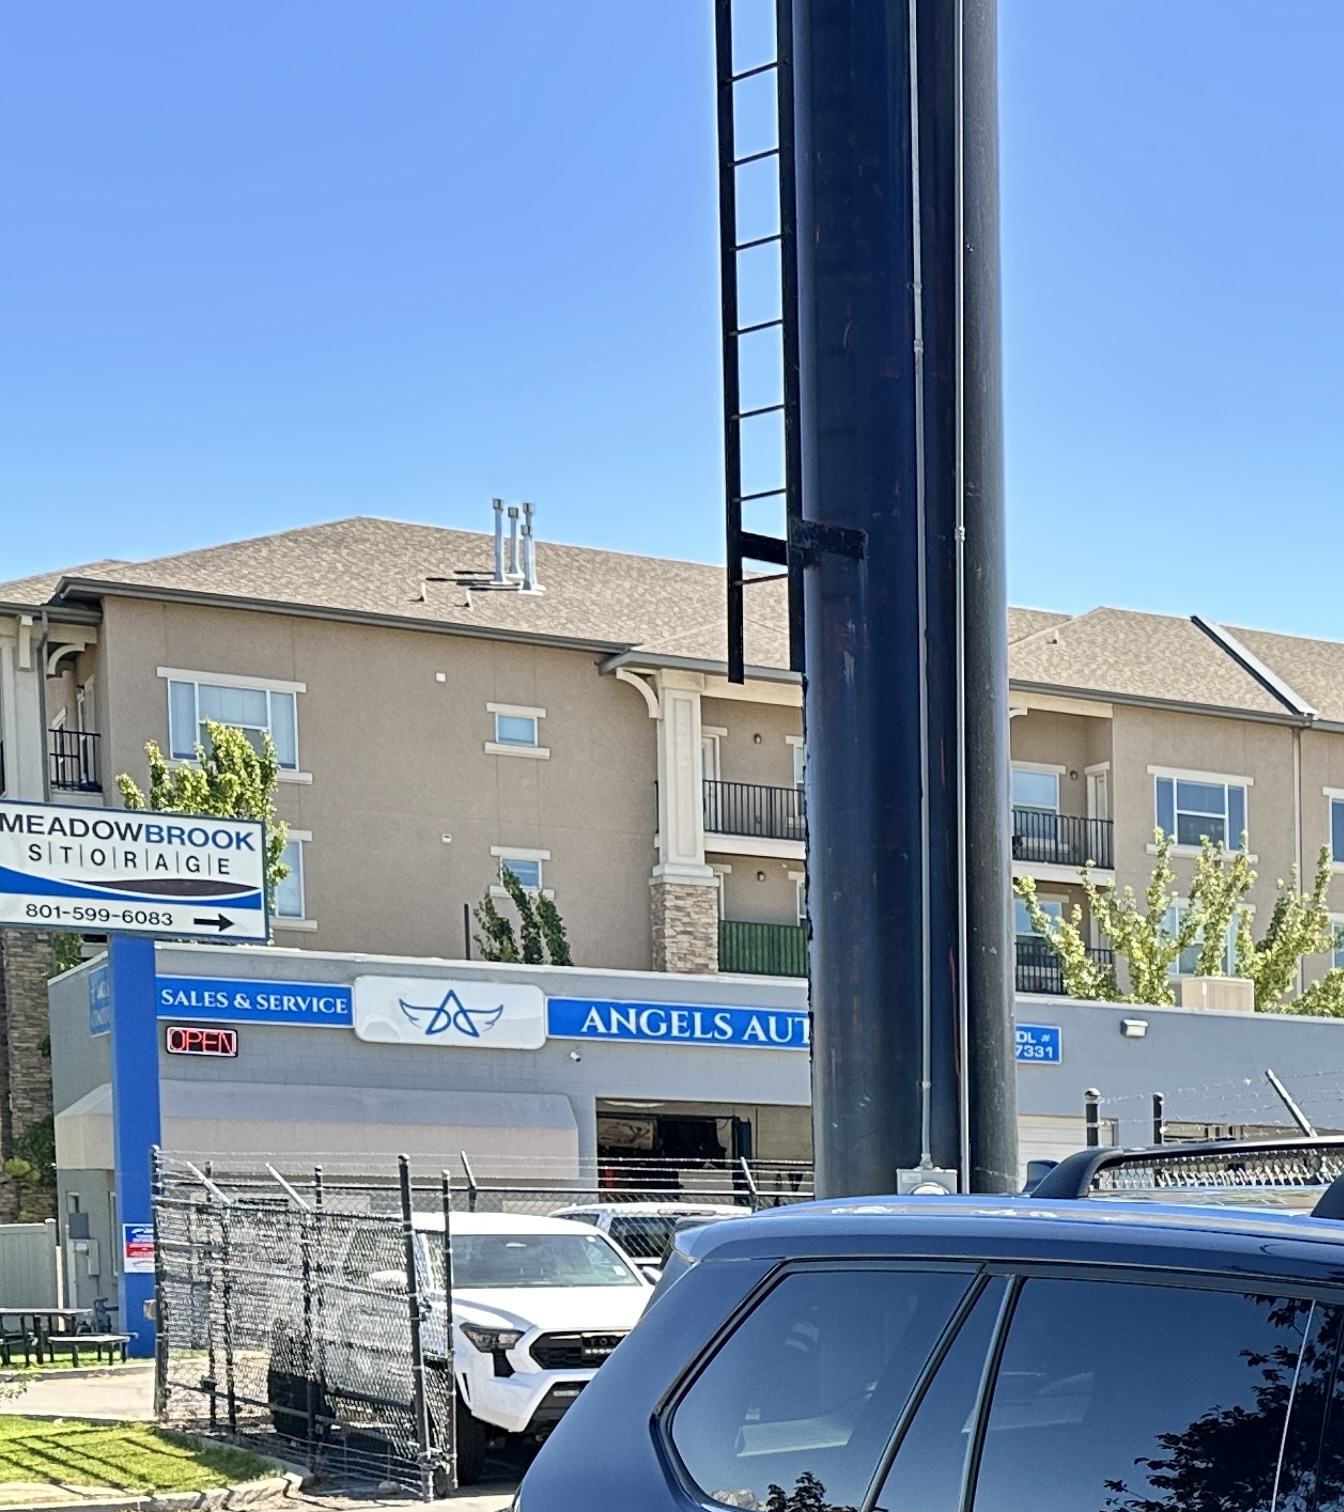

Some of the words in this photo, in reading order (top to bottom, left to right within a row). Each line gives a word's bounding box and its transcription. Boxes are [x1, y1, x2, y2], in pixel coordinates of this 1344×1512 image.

[0, 812, 256, 852] MEADOWBROOK
[25, 903, 174, 927] 801-599-6083
[160, 988, 229, 1009] SALES
[233, 992, 253, 1010] &
[256, 993, 349, 1015] SERVICE
[580, 1005, 734, 1041] ANGELS
[169, 1028, 234, 1054] OPEN
